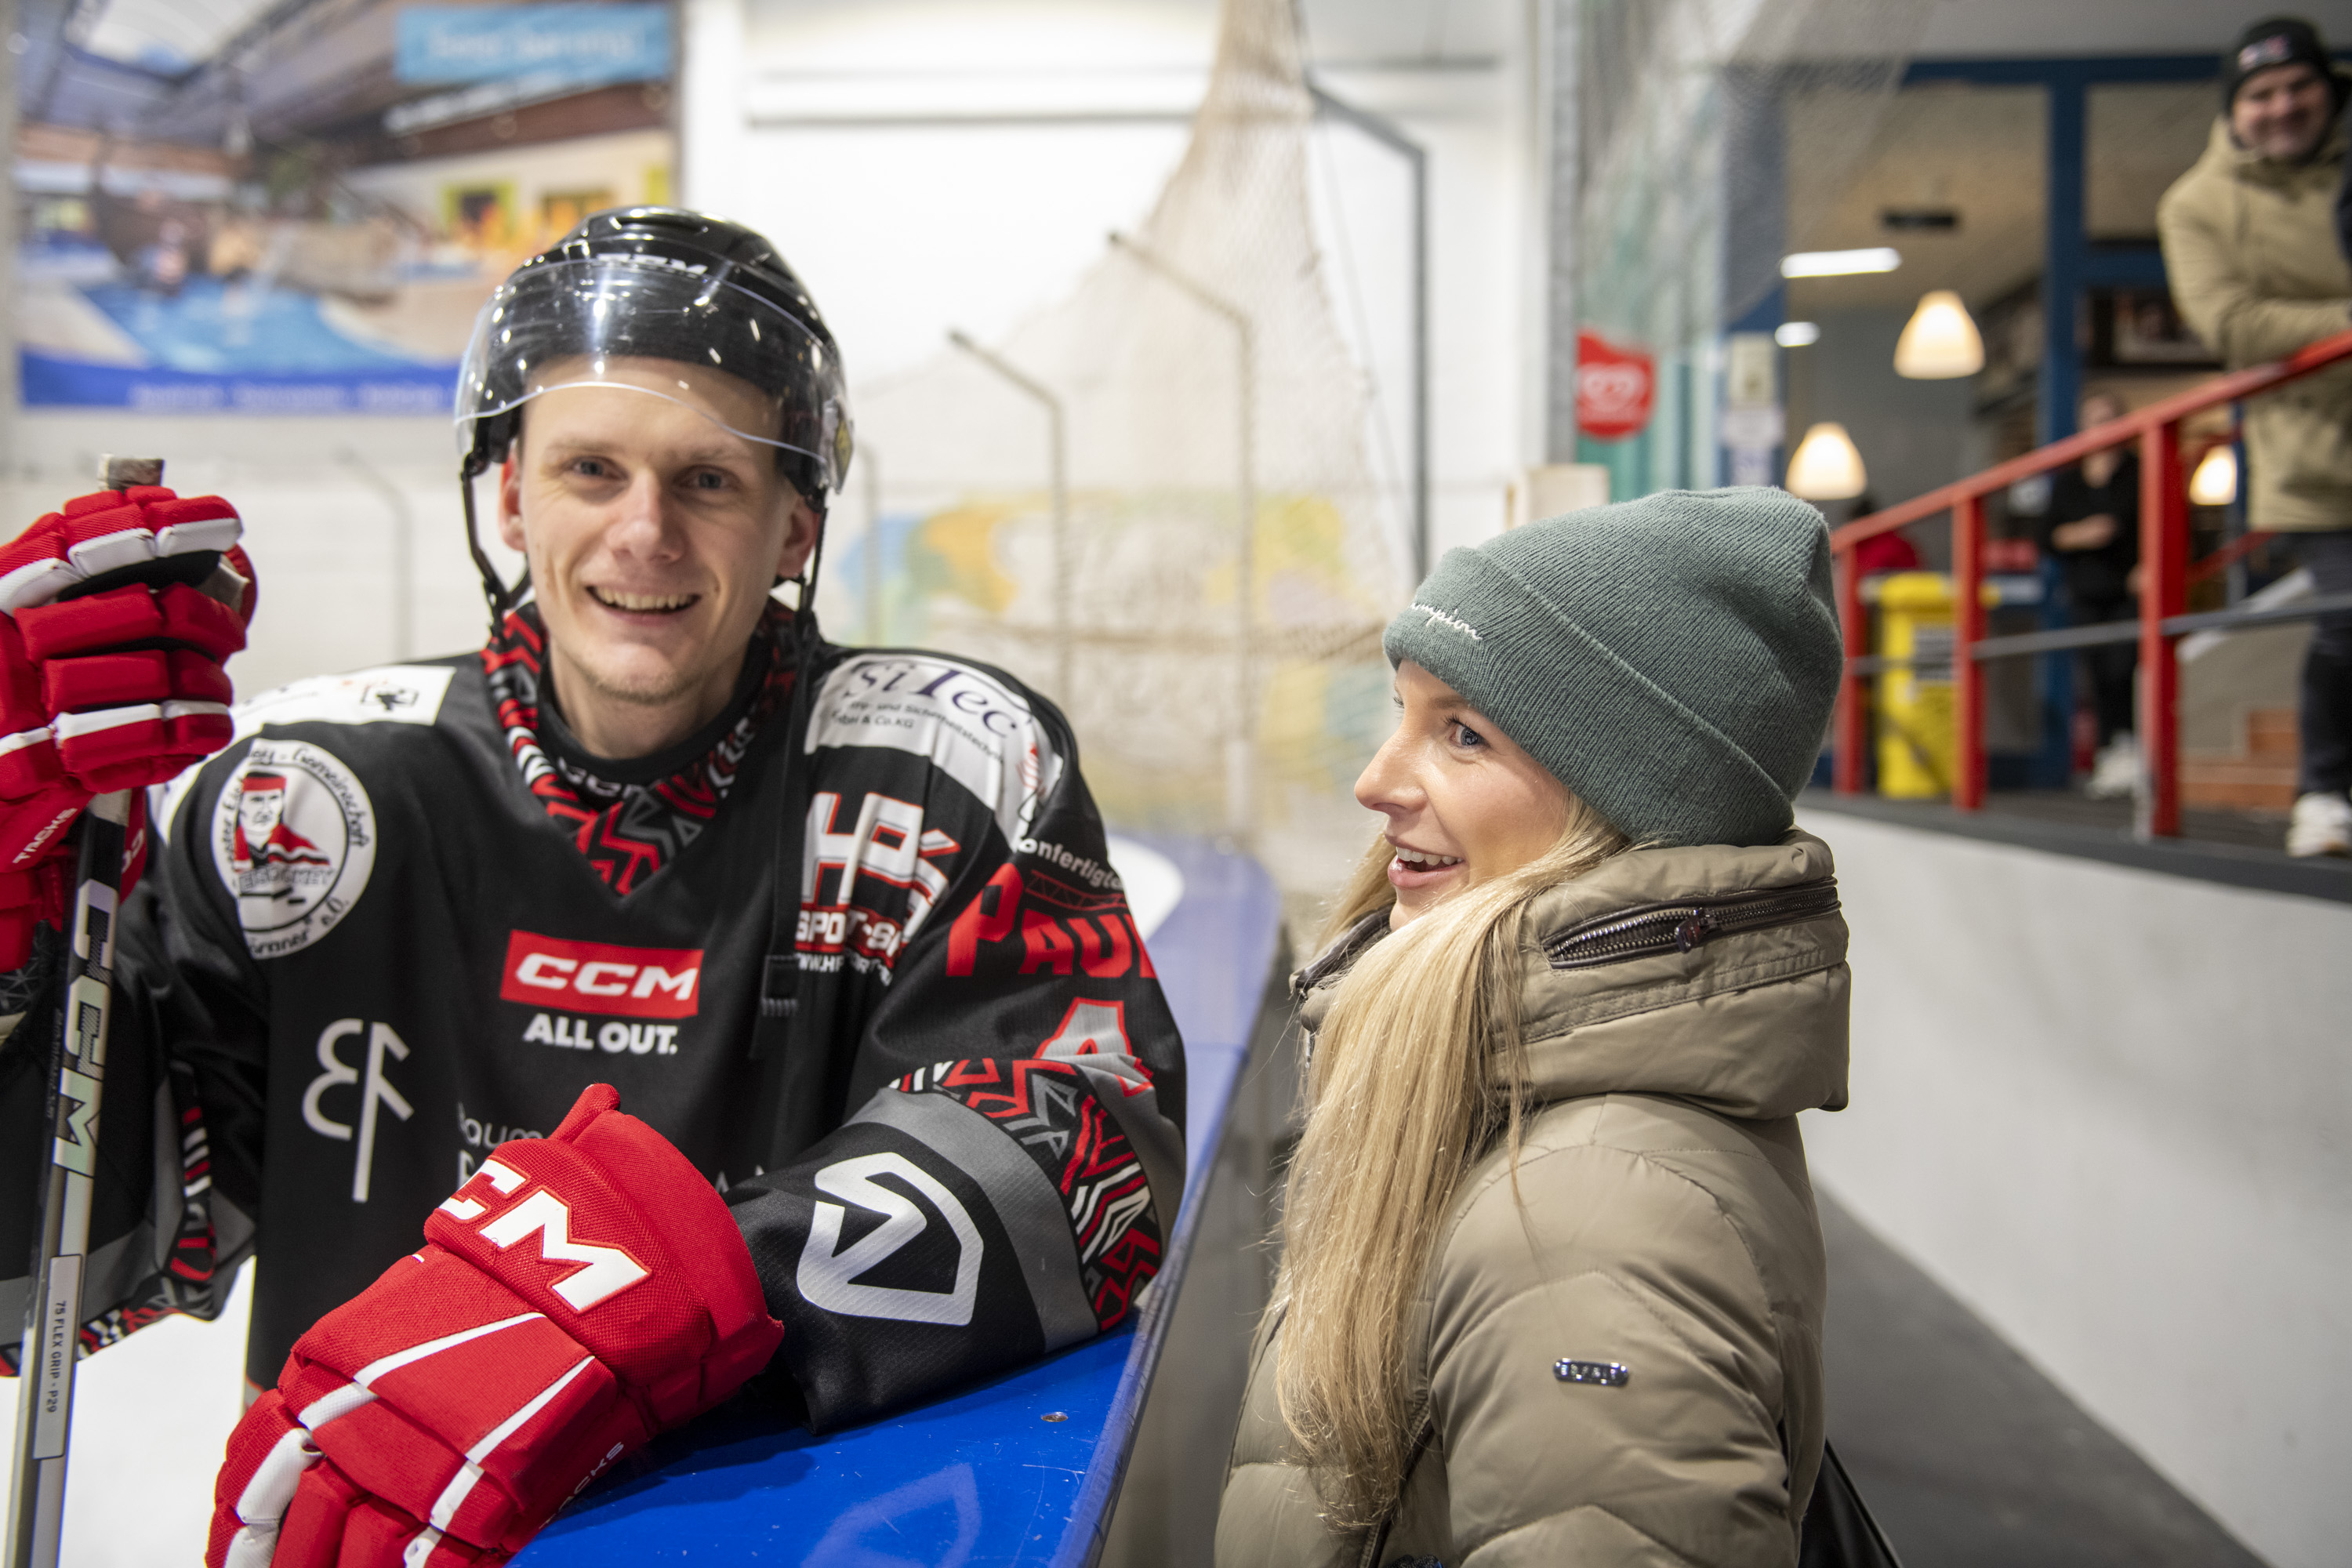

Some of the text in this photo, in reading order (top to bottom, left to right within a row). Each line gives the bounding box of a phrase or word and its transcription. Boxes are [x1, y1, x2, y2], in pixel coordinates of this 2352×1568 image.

[515, 953, 699, 1001] CCM
[52, 878, 119, 1179] CCM
[523, 1013, 678, 1055] ALL OUT.
[55, 1300, 67, 1316] 75
[50, 1318, 65, 1348] FLEX
[49, 1351, 63, 1380] GRIP
[46, 1388, 60, 1414] P29
